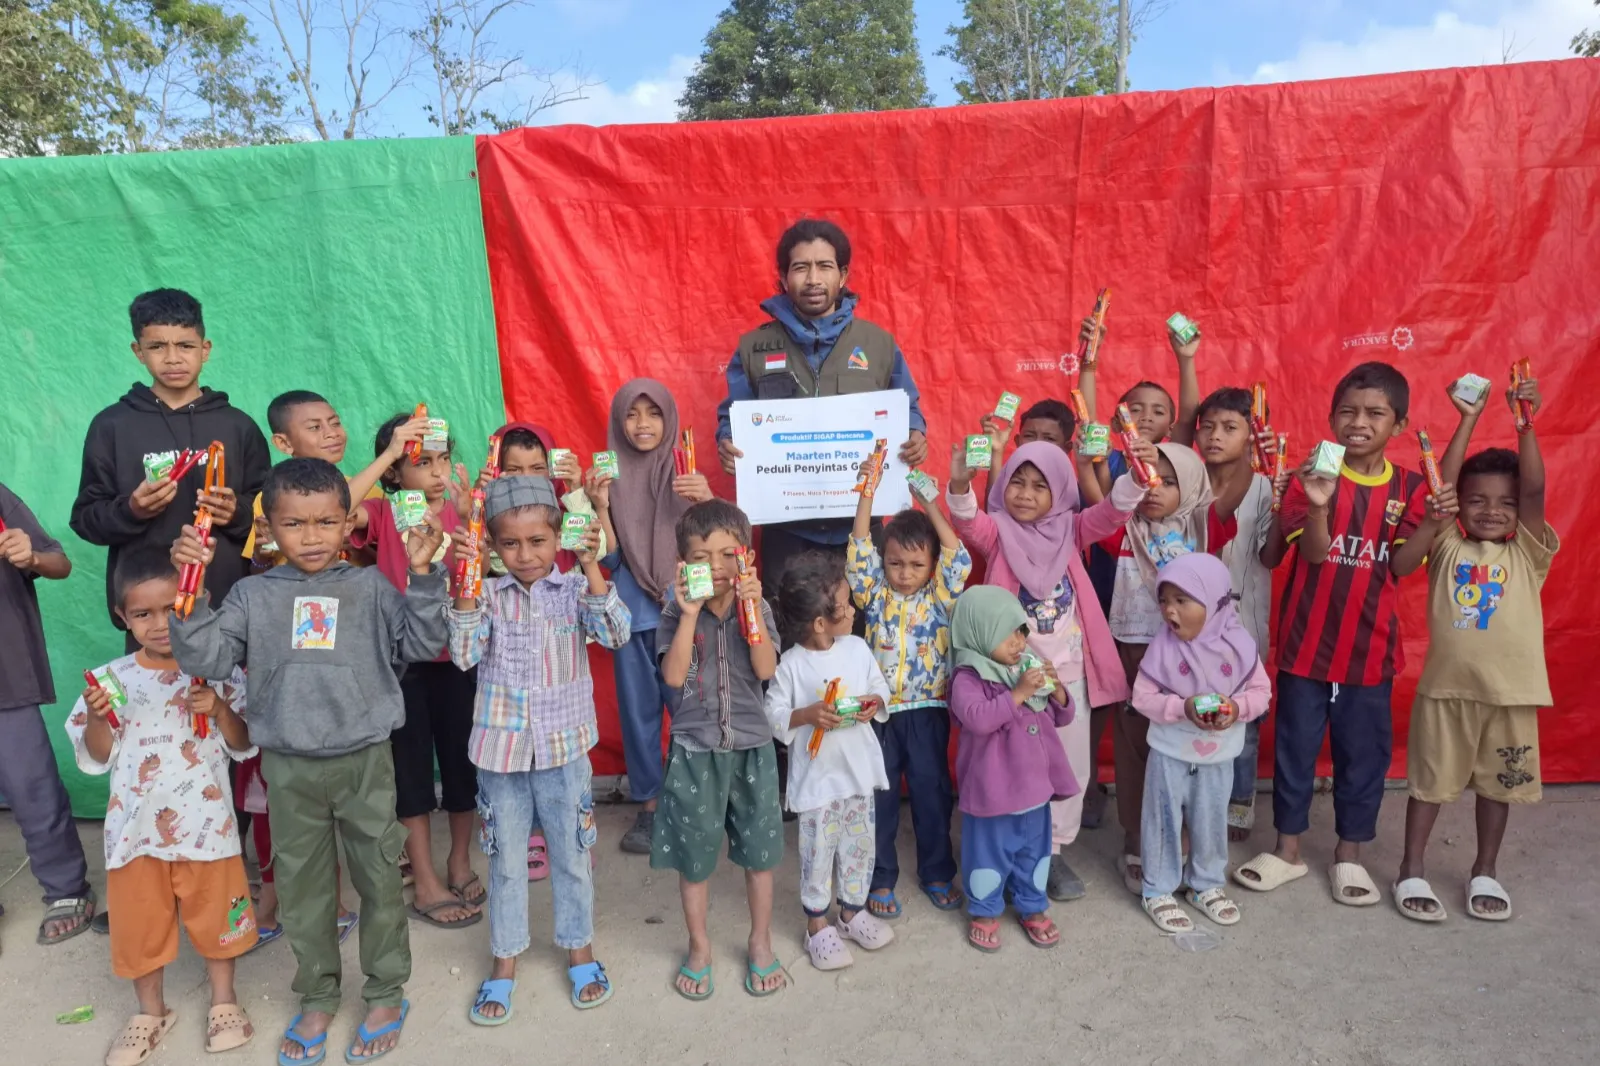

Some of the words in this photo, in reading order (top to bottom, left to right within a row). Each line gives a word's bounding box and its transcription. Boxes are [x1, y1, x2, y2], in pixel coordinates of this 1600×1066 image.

[1343, 335, 1388, 349] SAKURA
[780, 433, 812, 441] Produktif
[786, 451, 832, 461] Maarten
[834, 450, 860, 459] Paes
[756, 464, 791, 474] Peduli
[794, 462, 848, 474] Penyintas
[1328, 533, 1389, 562] ATAR
[1325, 554, 1371, 569] AIRWAYS
[692, 568, 707, 576] MILO
